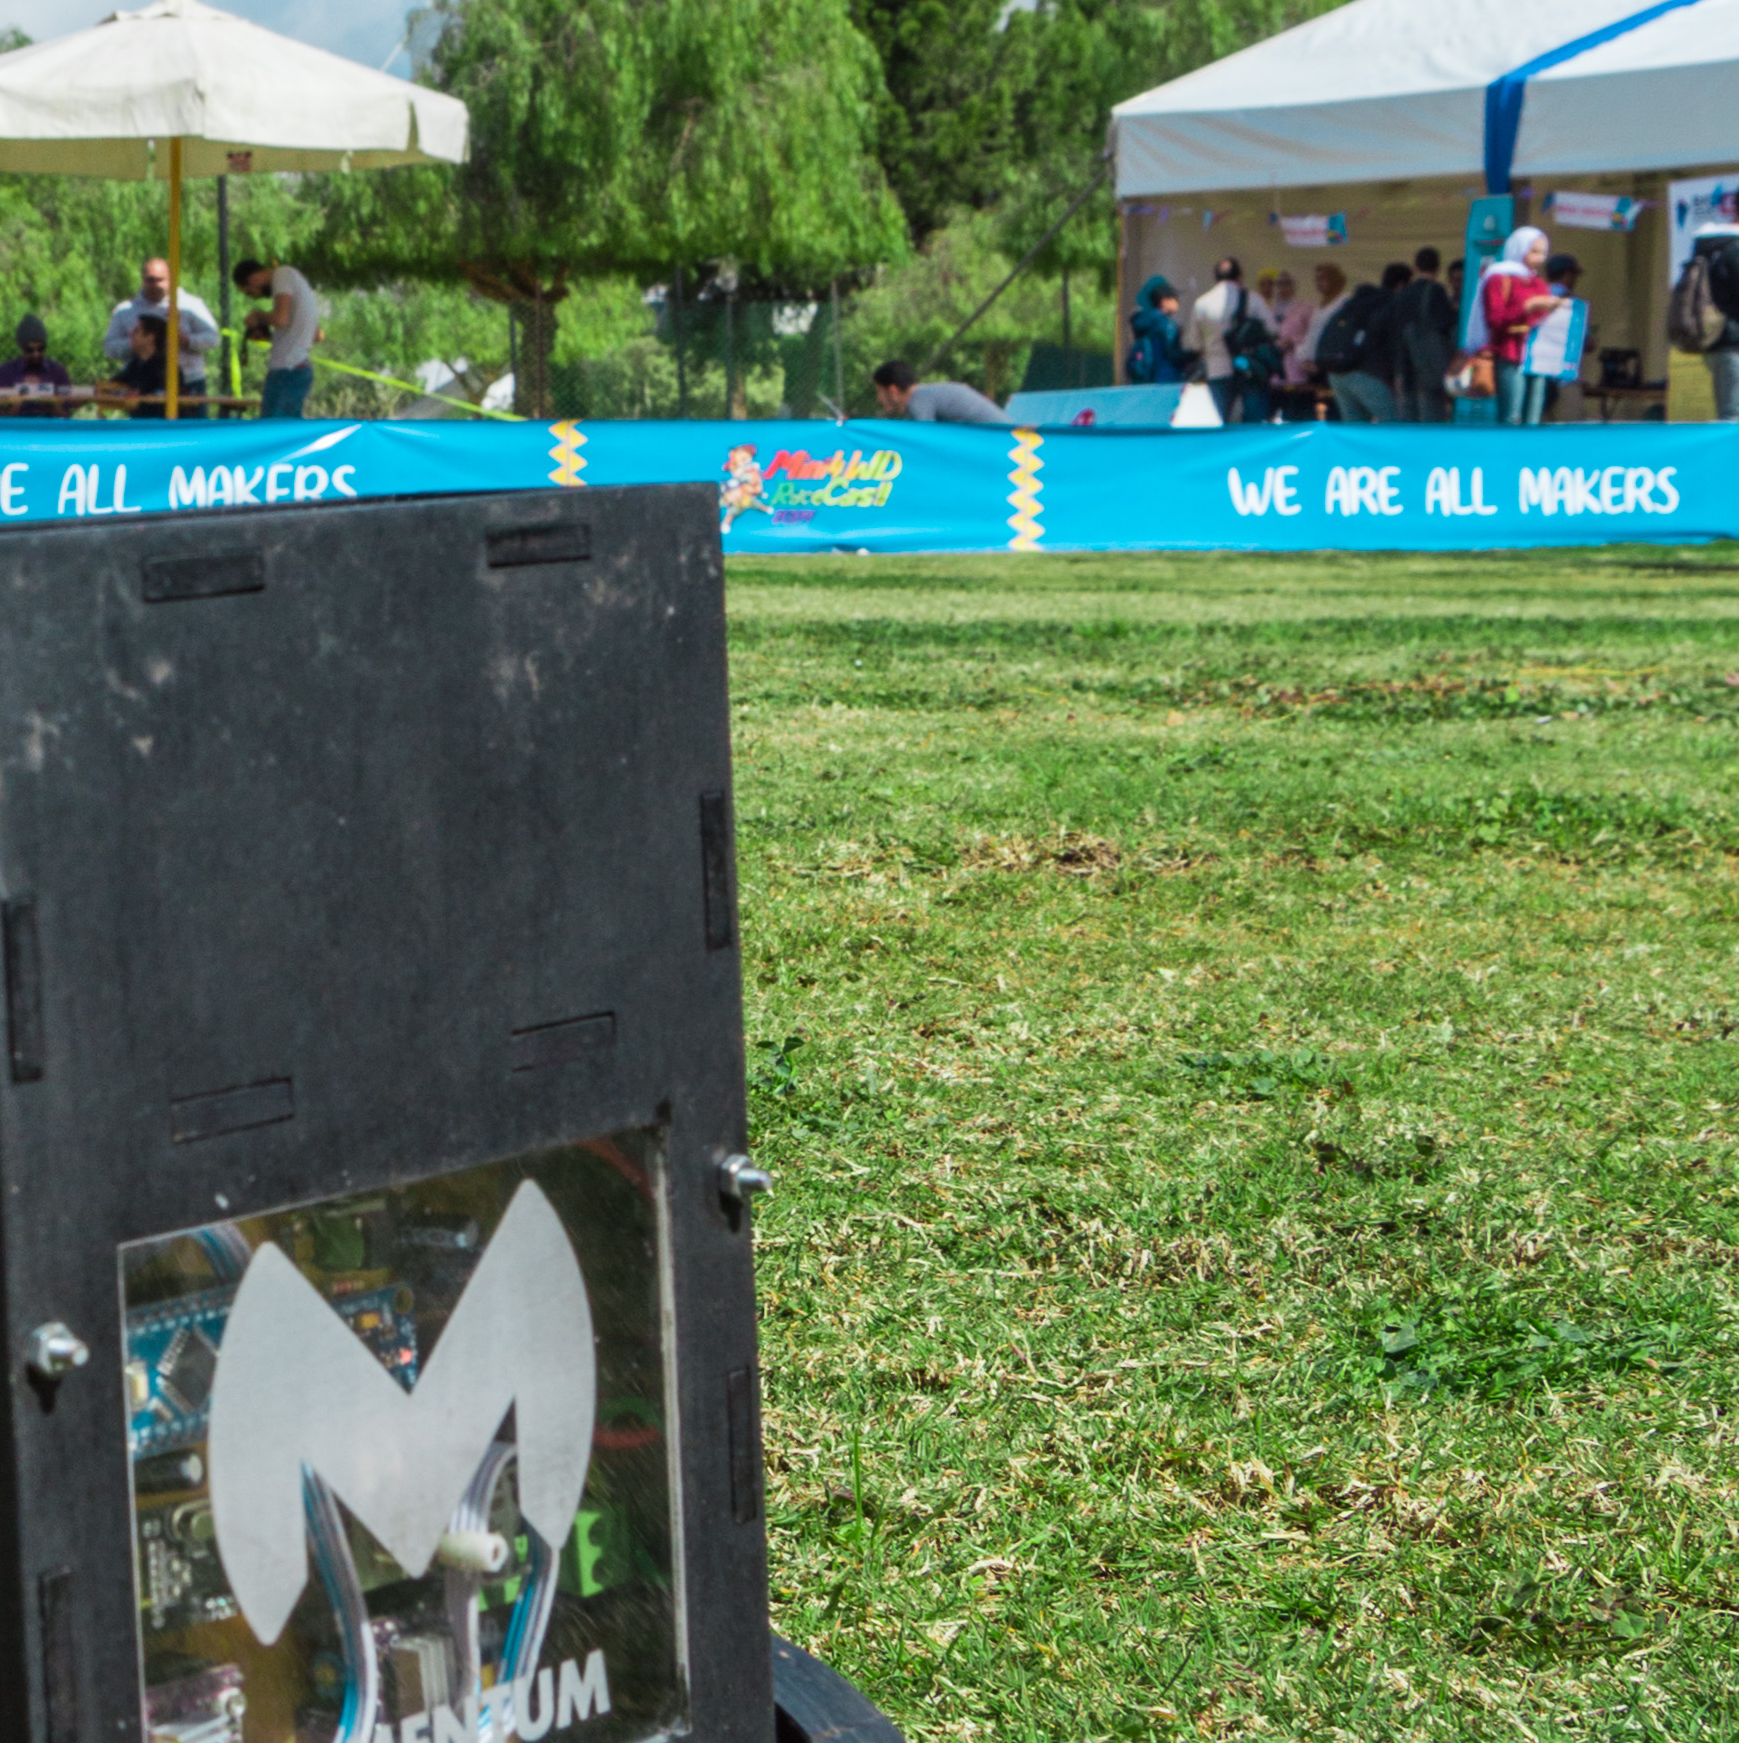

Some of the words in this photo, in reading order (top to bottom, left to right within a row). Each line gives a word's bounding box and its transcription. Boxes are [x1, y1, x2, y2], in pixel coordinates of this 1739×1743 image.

[57, 463, 143, 517] ALL
[168, 463, 358, 511] MAKERS
[1227, 465, 1303, 517] WE
[1324, 465, 1404, 517] ARE
[1425, 466, 1499, 517] ALL
[1518, 465, 1681, 517] MAKERS
